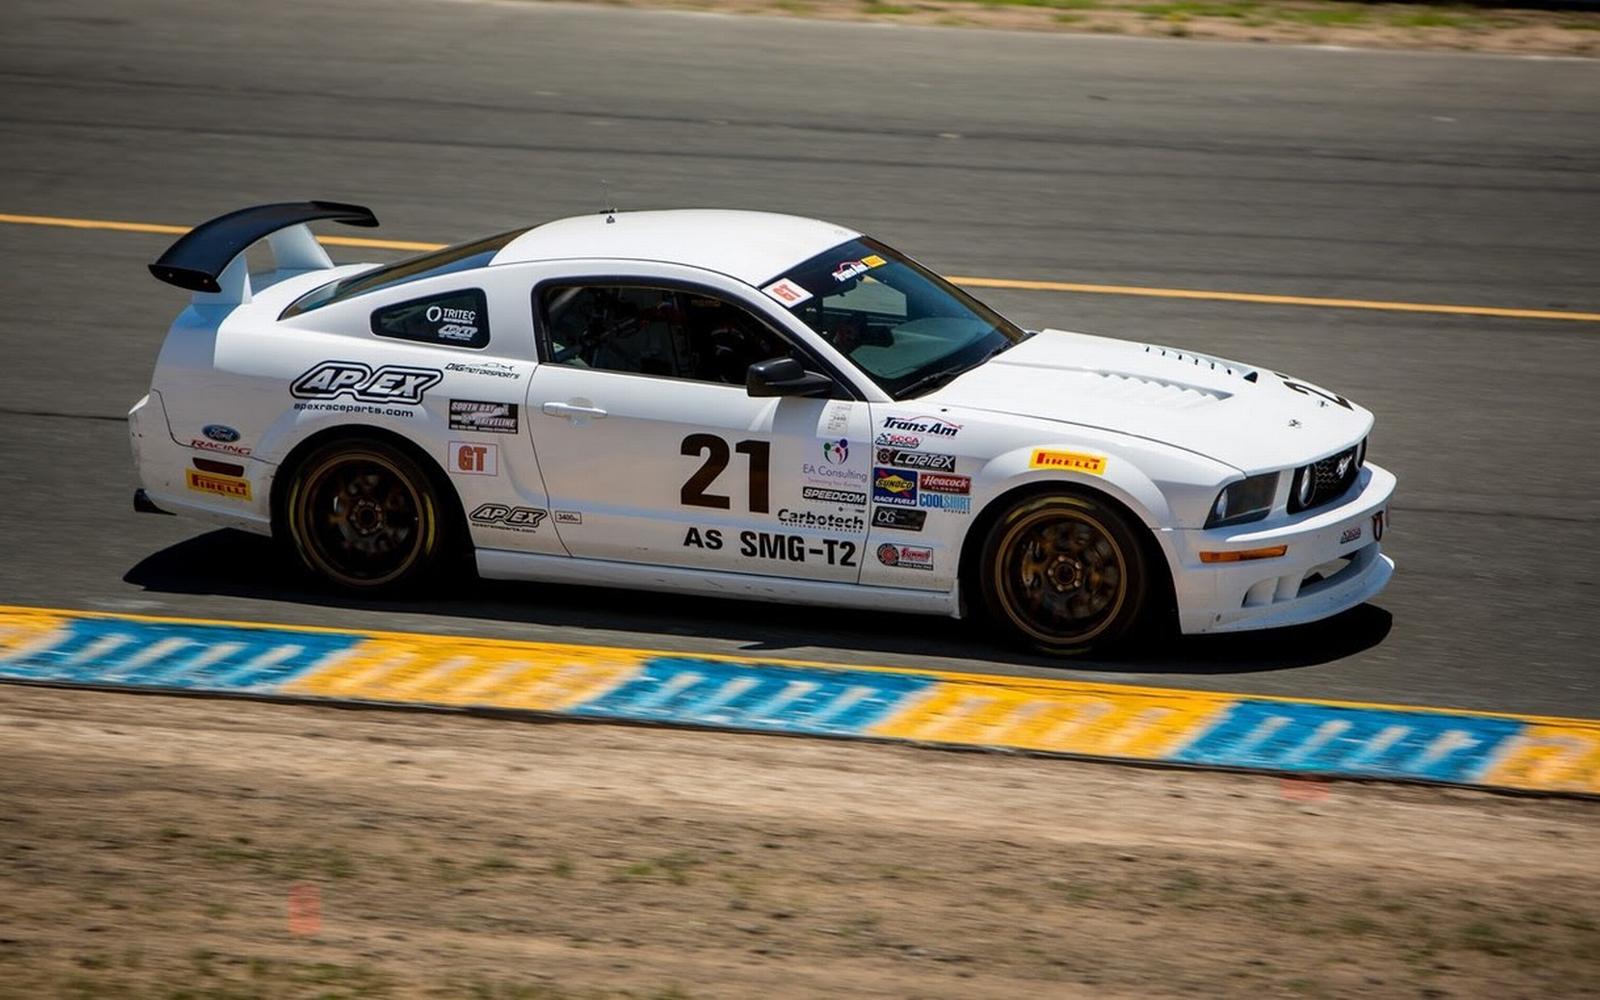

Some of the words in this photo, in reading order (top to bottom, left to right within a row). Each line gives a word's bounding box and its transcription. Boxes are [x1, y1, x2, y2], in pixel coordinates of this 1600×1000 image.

[443, 308, 476, 321] TRITEC
[296, 364, 437, 402] APEX
[294, 402, 413, 418] apexraceparts.com
[209, 428, 234, 439] Ford
[884, 416, 928, 432] Trans
[928, 423, 958, 436] Am
[191, 440, 252, 456] RACING
[459, 445, 487, 471] GT
[1036, 452, 1101, 470] PIRELLI
[681, 433, 770, 514] 21
[803, 464, 816, 475] EA
[818, 465, 868, 483] Consulting
[922, 475, 969, 488] Heacock
[191, 473, 247, 497] PIRELLI
[876, 478, 914, 490] SUNOCO
[804, 487, 866, 503] SPEEDCOM
[919, 493, 971, 511] COOLSHIRT
[473, 505, 545, 526] APEX
[778, 508, 864, 529] Carbotech
[683, 527, 723, 550] AS
[740, 531, 856, 567] SMG-T2
